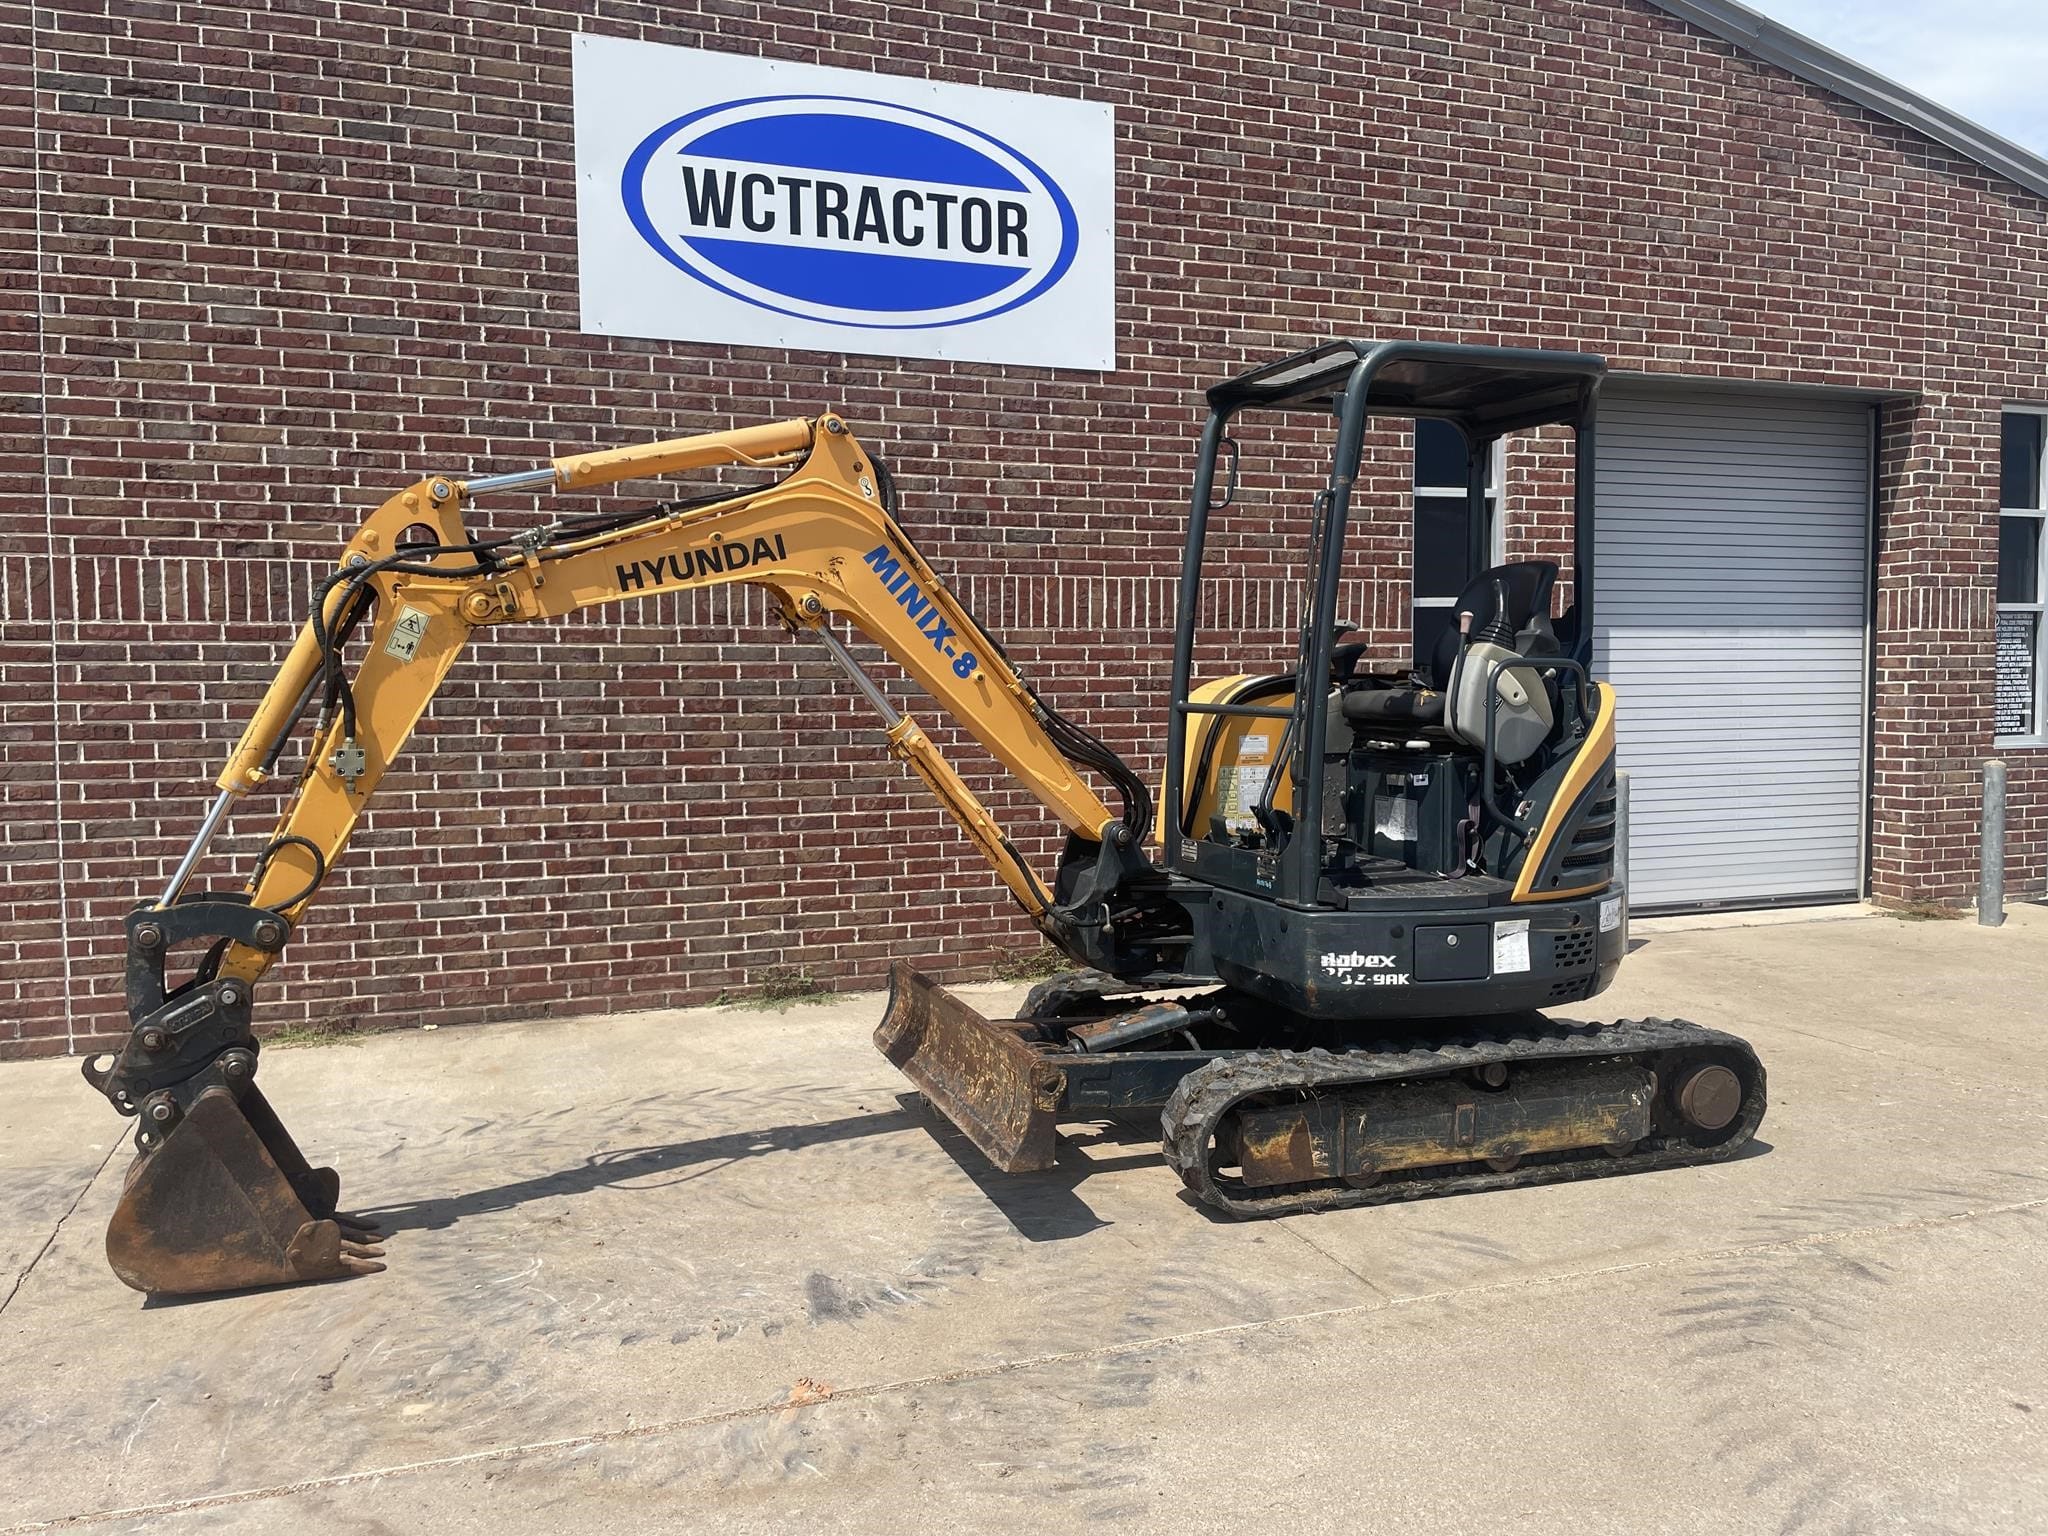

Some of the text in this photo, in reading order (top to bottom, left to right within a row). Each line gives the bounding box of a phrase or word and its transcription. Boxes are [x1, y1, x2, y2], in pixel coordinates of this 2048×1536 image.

[681, 166, 1030, 257] WCTRACTOR
[615, 533, 788, 593] HYUNDAI
[862, 544, 979, 679] MINIX-8
